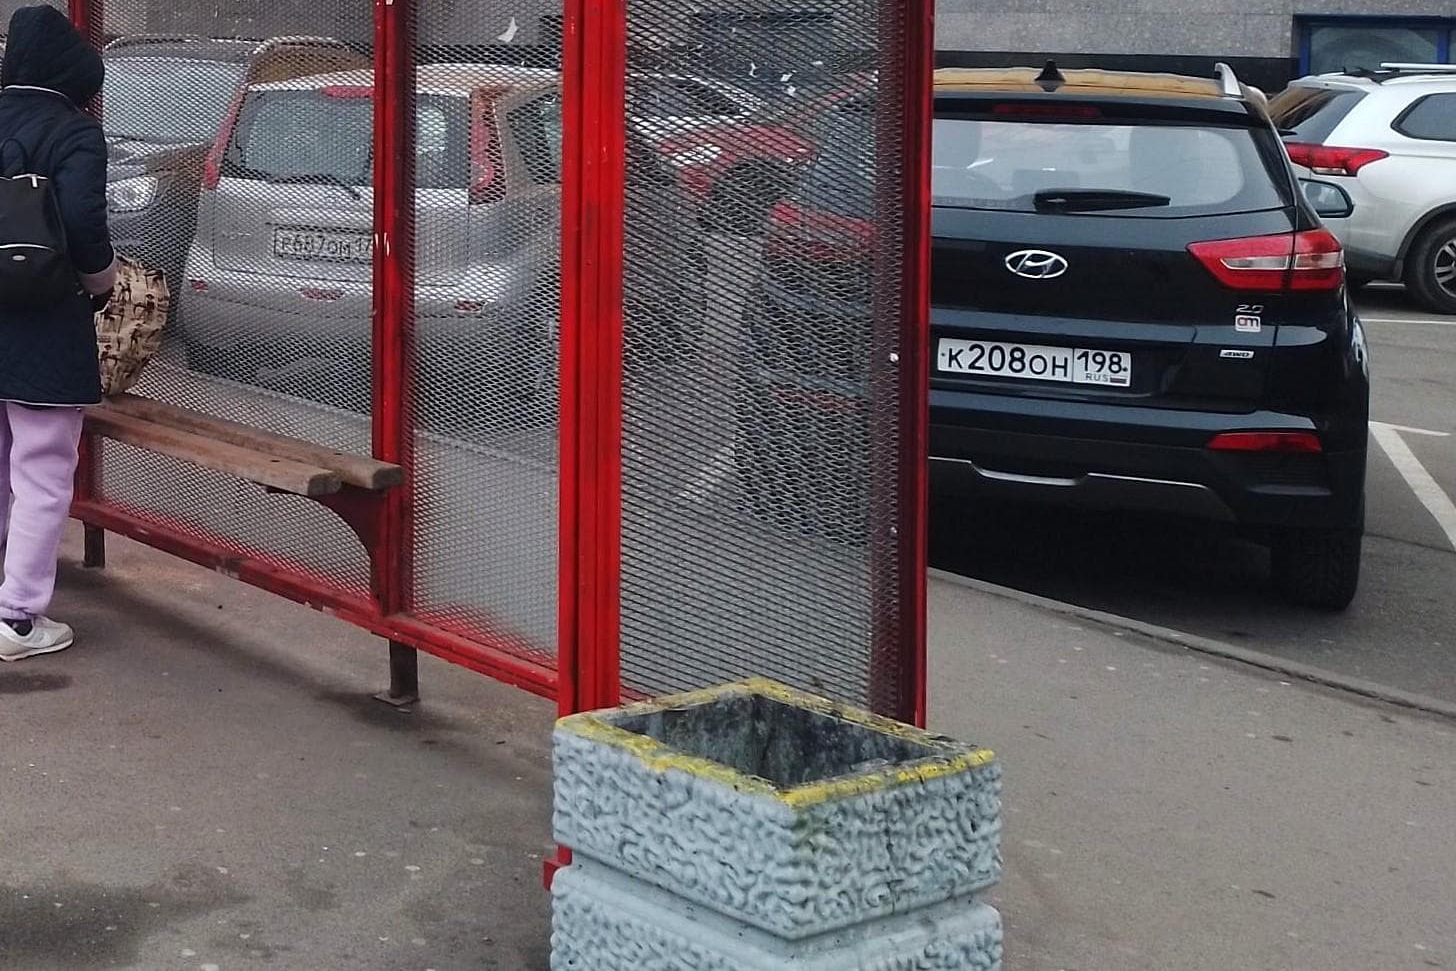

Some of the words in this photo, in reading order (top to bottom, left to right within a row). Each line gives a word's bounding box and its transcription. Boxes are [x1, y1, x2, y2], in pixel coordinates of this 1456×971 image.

[948, 343, 1068, 378] К208ОН
[1077, 350, 1122, 374] 198
[1086, 372, 1109, 383] RUS
